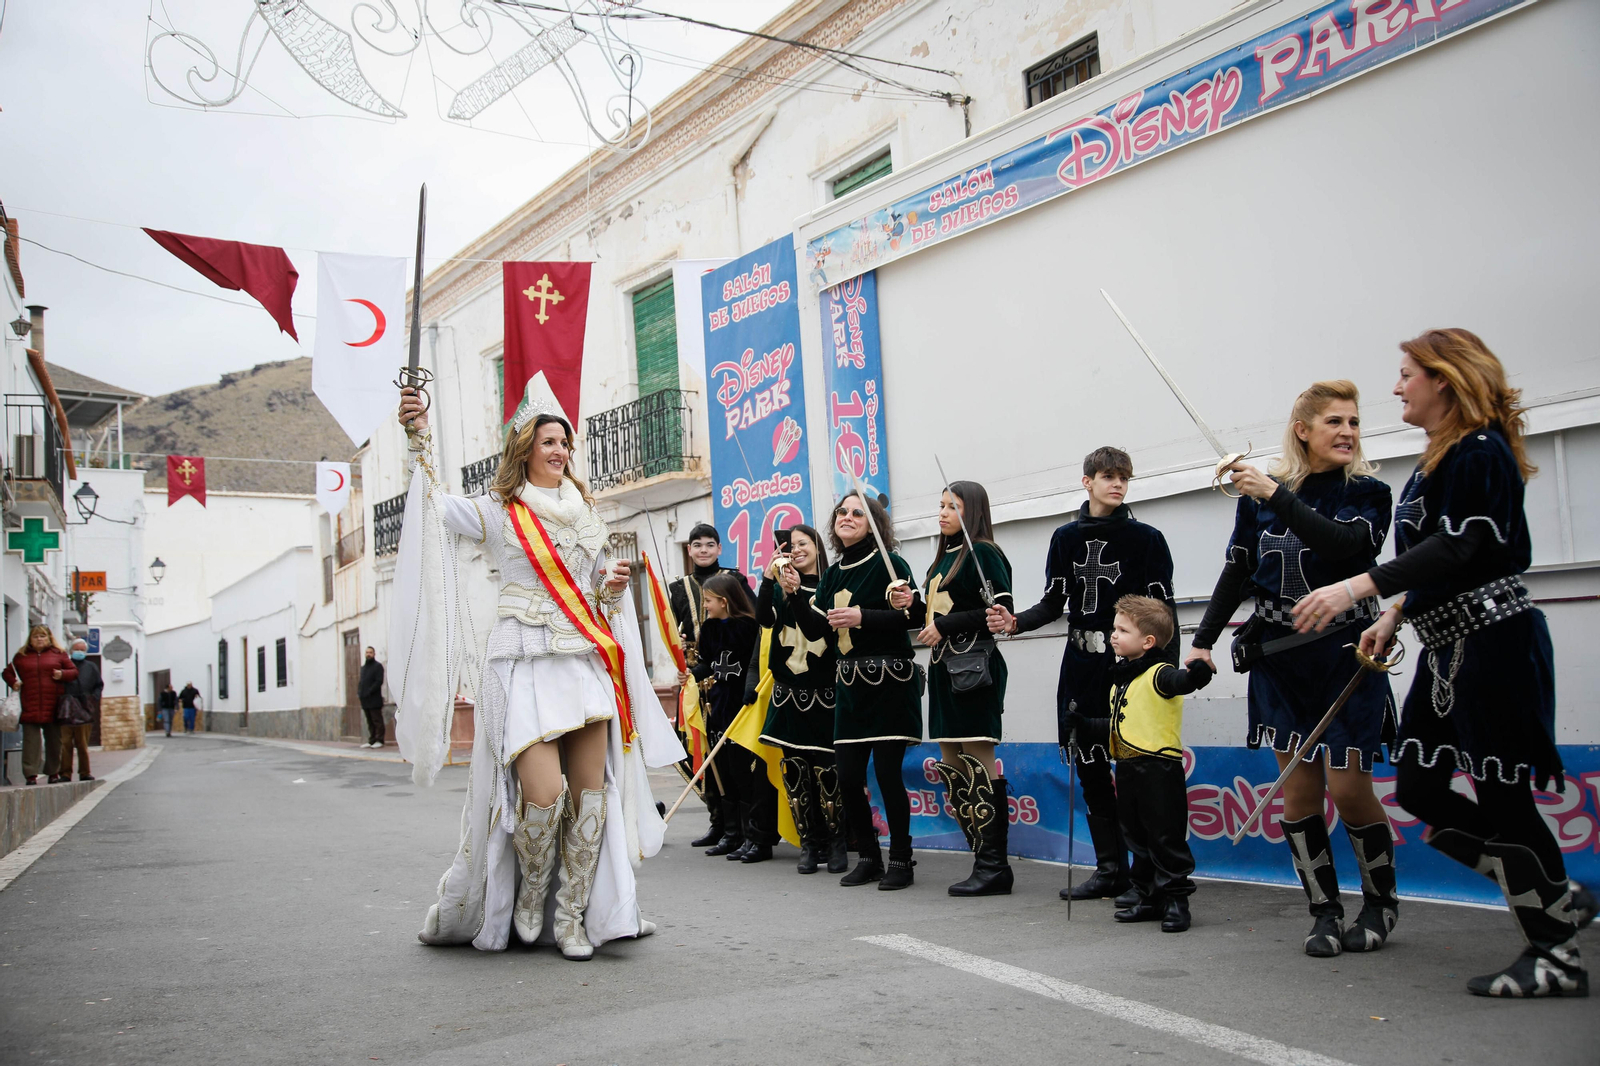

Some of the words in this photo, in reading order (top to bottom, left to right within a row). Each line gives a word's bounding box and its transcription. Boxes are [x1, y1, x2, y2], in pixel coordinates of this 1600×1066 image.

[928, 160, 995, 213] SALÓN
[911, 220, 936, 246] DE
[940, 184, 1018, 234] JUEGOS
[722, 262, 771, 302] SALÓN
[709, 306, 730, 332] DE
[732, 280, 791, 322] JUEGOS
[725, 378, 792, 440] PARK
[865, 380, 876, 396] 3
[721, 484, 733, 508] 3
[732, 471, 803, 507] Dardos
[75, 575, 104, 587] PAR
